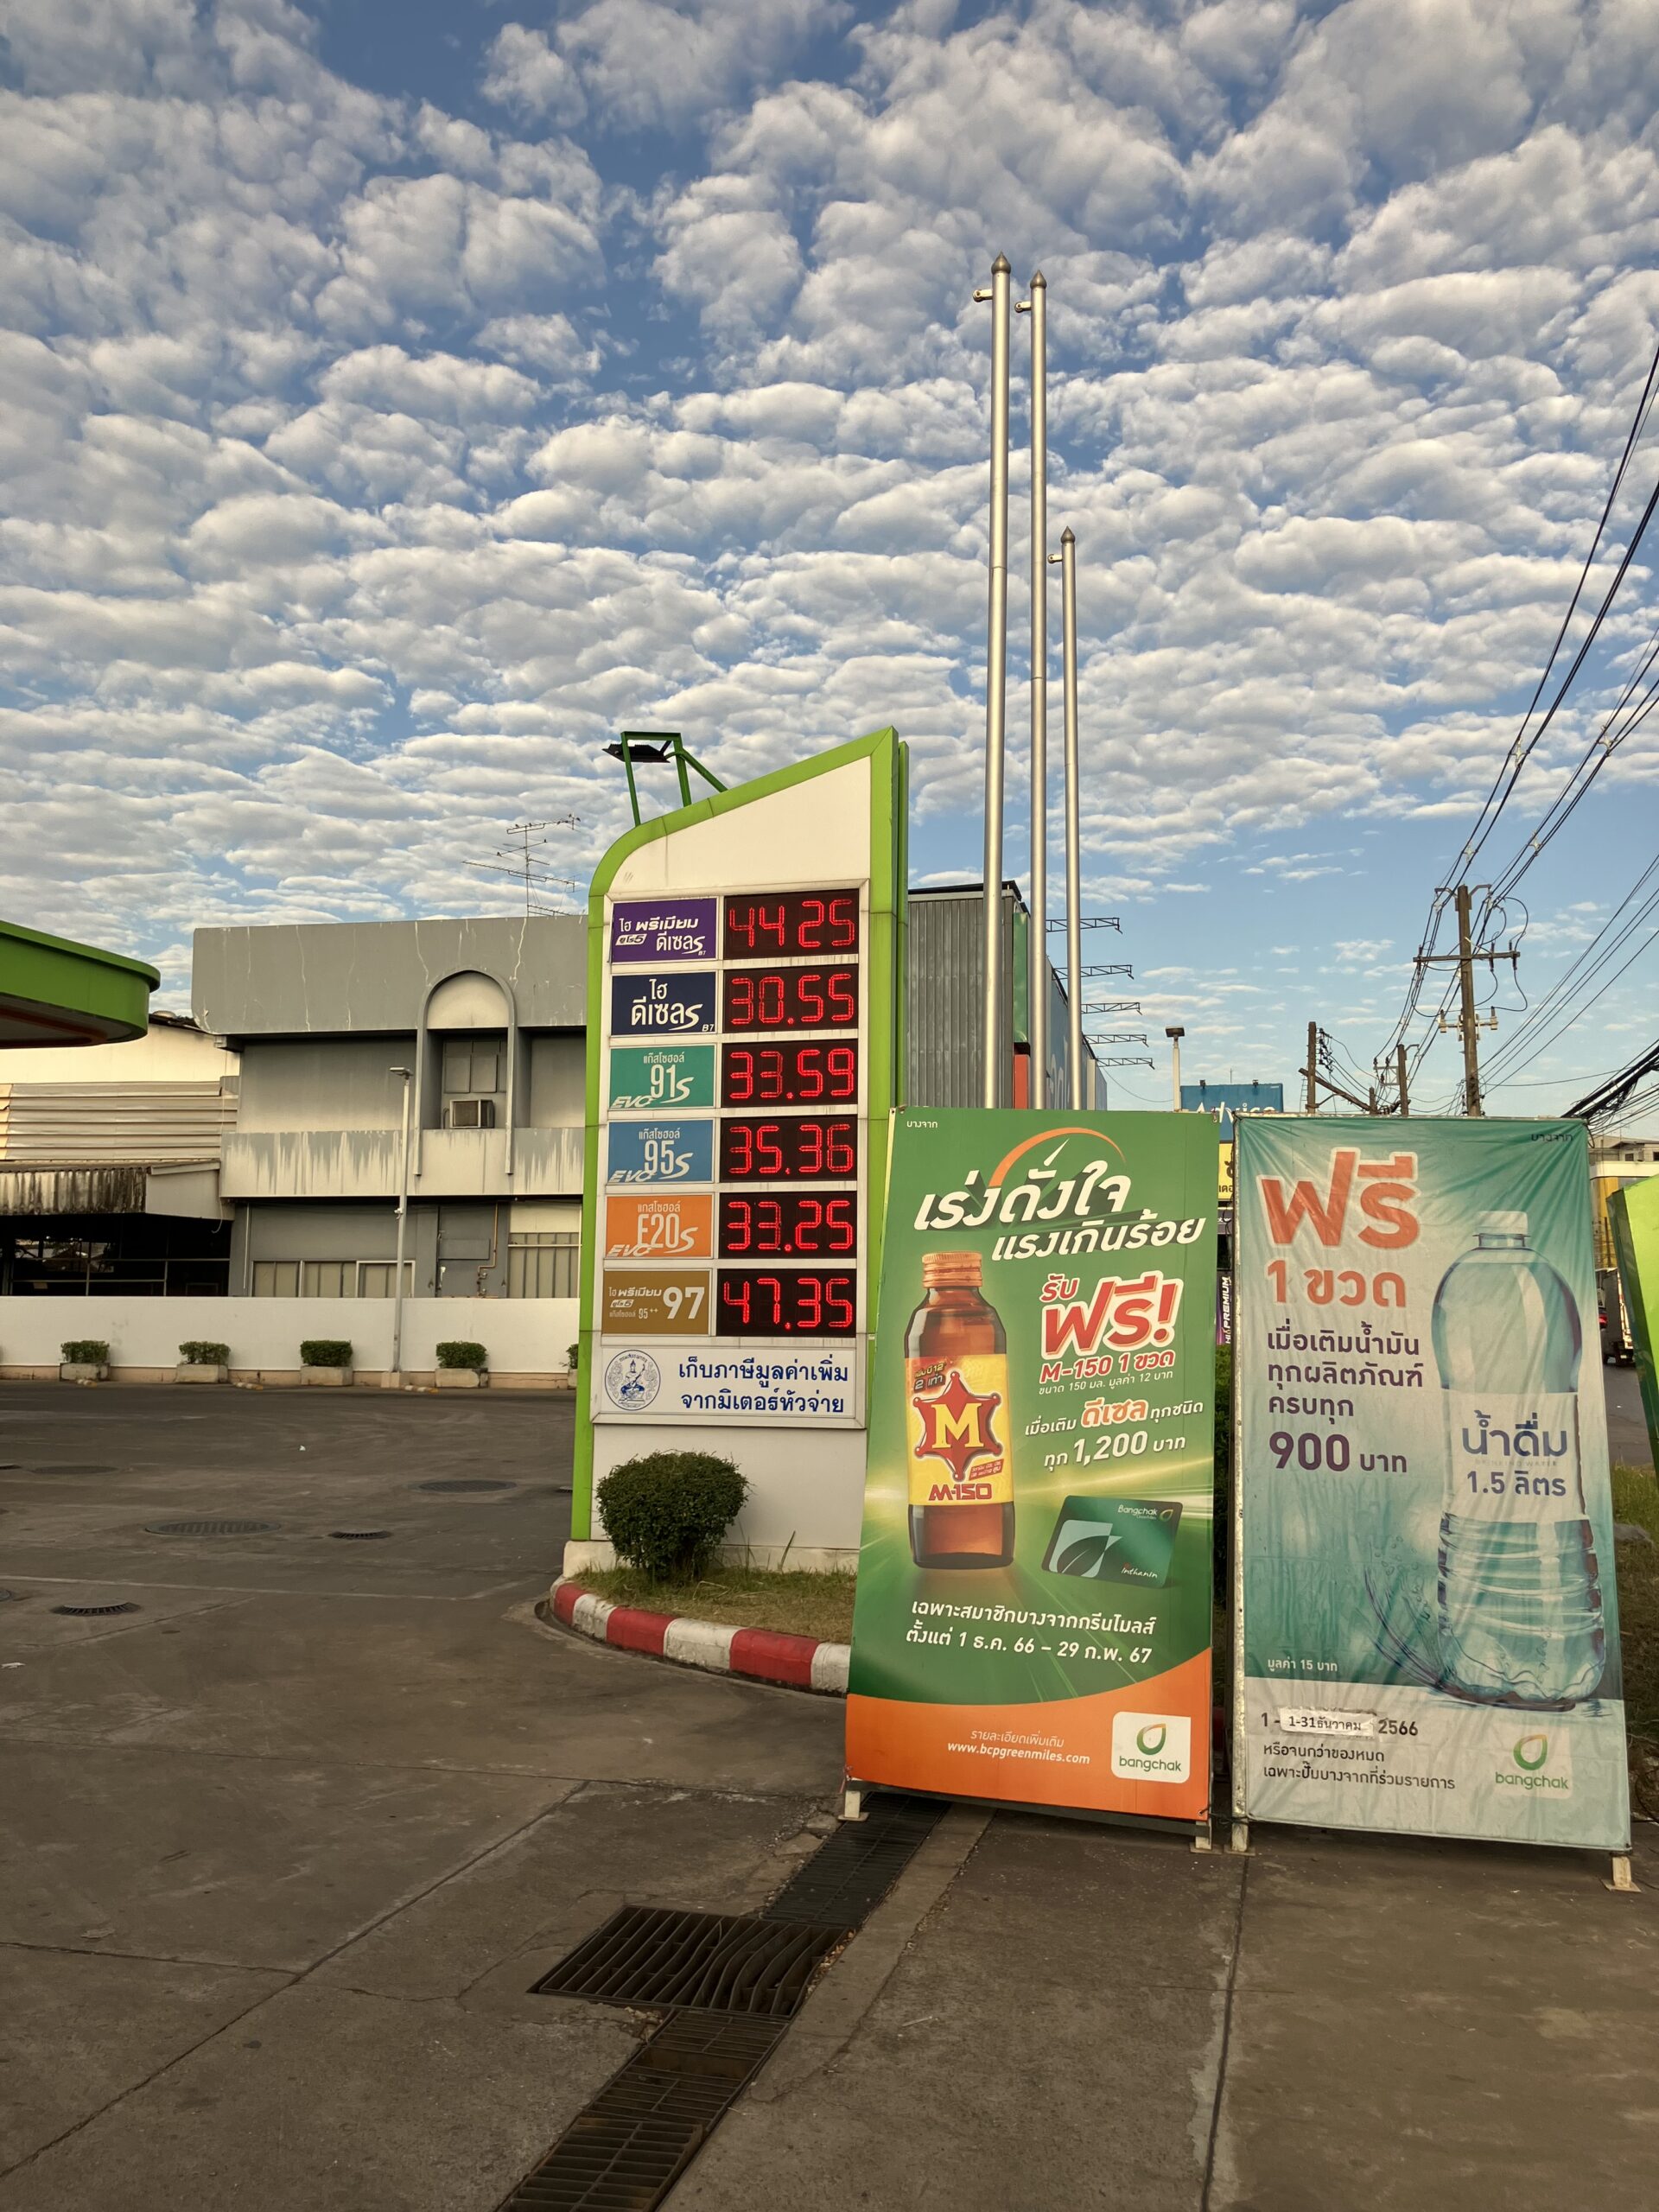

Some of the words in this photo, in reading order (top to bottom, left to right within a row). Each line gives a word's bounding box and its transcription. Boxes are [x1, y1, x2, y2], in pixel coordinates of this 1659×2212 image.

[635, 916, 698, 931] พรีเมียม
[649, 979, 668, 1000] ไฮ
[731, 974, 854, 1025] 30.55
[729, 1048, 854, 1099] 33.59
[728, 1124, 854, 1174] 35.36
[1259, 1149, 1420, 1249] ฟรี
[728, 1200, 854, 1251] 33.25
[991, 1209, 1207, 1262] แรงเกินร้อย
[1039, 1274, 1079, 1302] รับ
[1267, 1260, 1287, 1304] 1
[1304, 1268, 1407, 1307] ขวด
[663, 1287, 705, 1319] 97
[723, 1278, 853, 1330] 47.35
[1043, 1273, 1181, 1357] ฟรี!
[1222, 1276, 1230, 1328] PREMIUM
[1267, 1319, 1420, 1356] เมื่อเติมน้ำมัน
[679, 1354, 848, 1388] เก็บภาษีมูลค่าเพิ่ม
[1039, 1384, 1065, 1395] ขนาด
[1069, 1381, 1086, 1391] 150
[1089, 1380, 1106, 1389] มล.
[1109, 1374, 1135, 1389] มูลค่า
[1139, 1373, 1151, 1382] 12
[1154, 1371, 1173, 1381] บาท
[1040, 1355, 1112, 1383] M-150
[1119, 1352, 1130, 1373] 1
[1135, 1350, 1175, 1370] ขวด
[1268, 1361, 1424, 1390] ทุกผลิตภัณฑ์
[681, 1388, 844, 1413] จากมิเตอร์หัวจ่าย
[1025, 1415, 1077, 1436] เมื่อเติม
[1081, 1397, 1148, 1427] ดีเซล
[1150, 1400, 1204, 1423] ทุกชนิด
[1268, 1397, 1354, 1425] ครบทุก
[931, 1402, 984, 1450] M
[1462, 1409, 1567, 1457] น้ำดื่ม
[1044, 1452, 1068, 1471] ทุก
[1073, 1431, 1148, 1466] 1,200
[1153, 1436, 1186, 1452] บาท
[1268, 1431, 1351, 1471] 900
[1360, 1452, 1408, 1473] บาท
[928, 1484, 992, 1501] M-150
[1467, 1471, 1505, 1494] 1.5
[1514, 1470, 1567, 1497] ลิตร
[912, 1601, 1157, 1635] เฉพาะสมาชิกบางจากกรีนไมลส์
[906, 1619, 953, 1646] ตั้งแต่
[959, 1632, 968, 1647] 1
[973, 1635, 1007, 1651] ธ.ค.
[1014, 1637, 1035, 1654] 66
[1057, 1642, 1079, 1658] 29
[1084, 1646, 1122, 1662] ก.พ.
[1129, 1648, 1152, 1664] 67
[1268, 1657, 1296, 1672] มูลค่า
[1300, 1660, 1313, 1670] 15
[1317, 1662, 1338, 1672] บาท
[970, 1730, 1065, 1748] รายละเอียดเพิ่มเติม
[1378, 1719, 1419, 1736] 2566
[947, 1742, 1090, 1764] www.bcpgreenmiles.com
[1119, 1755, 1182, 1772] bangchak
[1263, 1742, 1385, 1762] หรือจนกว่าของหมด
[1263, 1761, 1456, 1789] เฉพาะปั๊มบางจากที่ร่วมรายการ
[1495, 1770, 1569, 1790] bangchak
